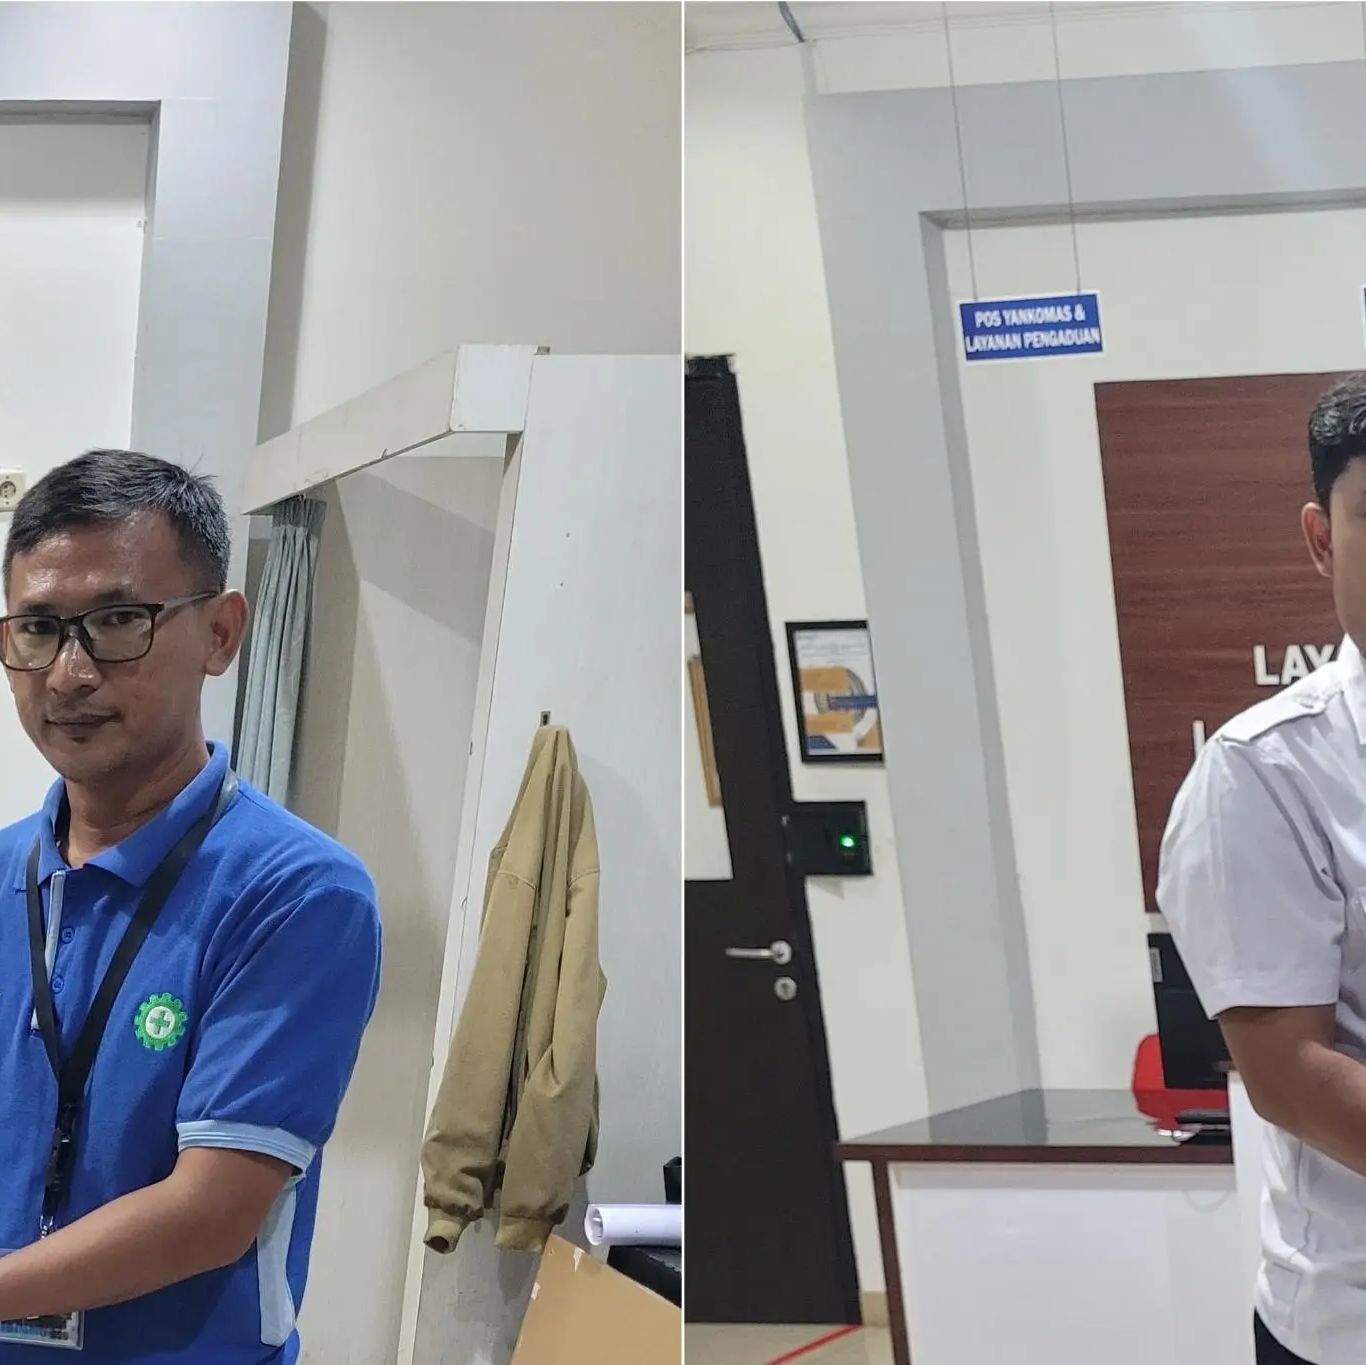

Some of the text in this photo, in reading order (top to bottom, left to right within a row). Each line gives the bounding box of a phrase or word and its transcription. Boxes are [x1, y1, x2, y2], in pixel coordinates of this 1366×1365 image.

[974, 303, 1086, 328] POS YANKOMAS &
[965, 327, 1101, 353] LAYANAN PENGADUAN
